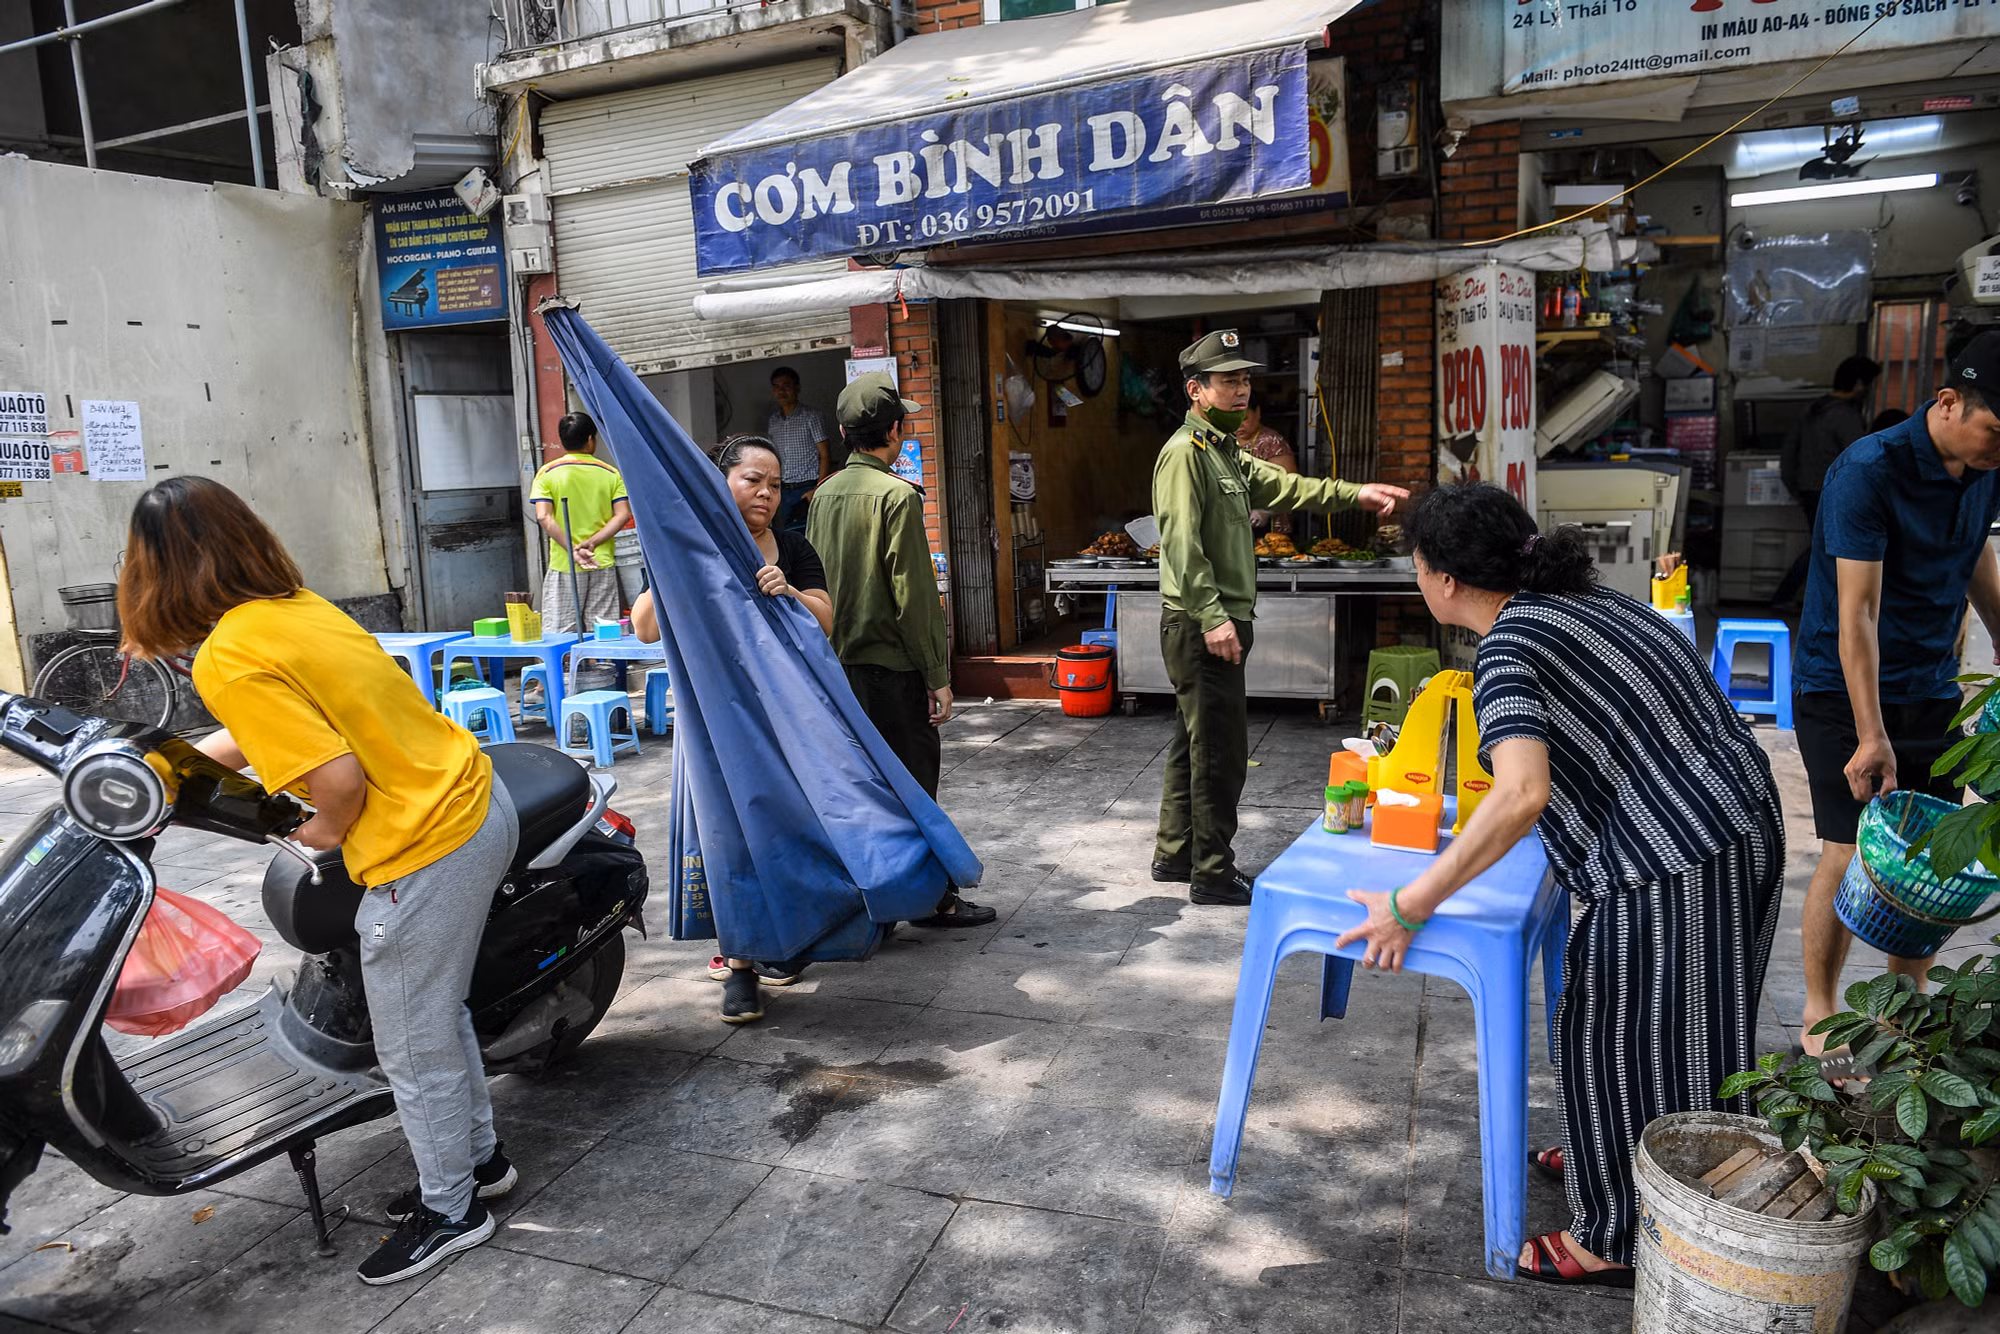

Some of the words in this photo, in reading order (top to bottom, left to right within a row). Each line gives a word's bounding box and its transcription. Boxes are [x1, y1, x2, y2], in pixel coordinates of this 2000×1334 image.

[1512, 12, 1535, 29] 24
[1701, 23, 1718, 41] IN
[1722, 16, 1758, 38] MÀU
[1825, 4, 1870, 25] ĐÓNG
[1521, 68, 1558, 85] Mail:
[1563, 46, 1752, 82] photo24ltt@gmail.com
[714, 161, 855, 232] CƠM
[873, 123, 1065, 207] BÌNH
[1086, 83, 1280, 173] DÂN
[424, 198, 437, 209] VÀ
[451, 216, 456, 226] 5
[856, 219, 913, 248] ĐT:
[921, 207, 969, 238] 036
[976, 188, 1097, 229] 9572091
[403, 253, 432, 263] ORGAN
[436, 249, 461, 260] PIANO
[1464, 278, 1487, 299] Dân
[1441, 344, 1487, 434] PHO
[1499, 344, 1532, 431] PHO
[12, 421, 29, 433] 115
[31, 422, 47, 433] 838
[17, 468, 33, 479] 115
[35, 468, 51, 479] 838
